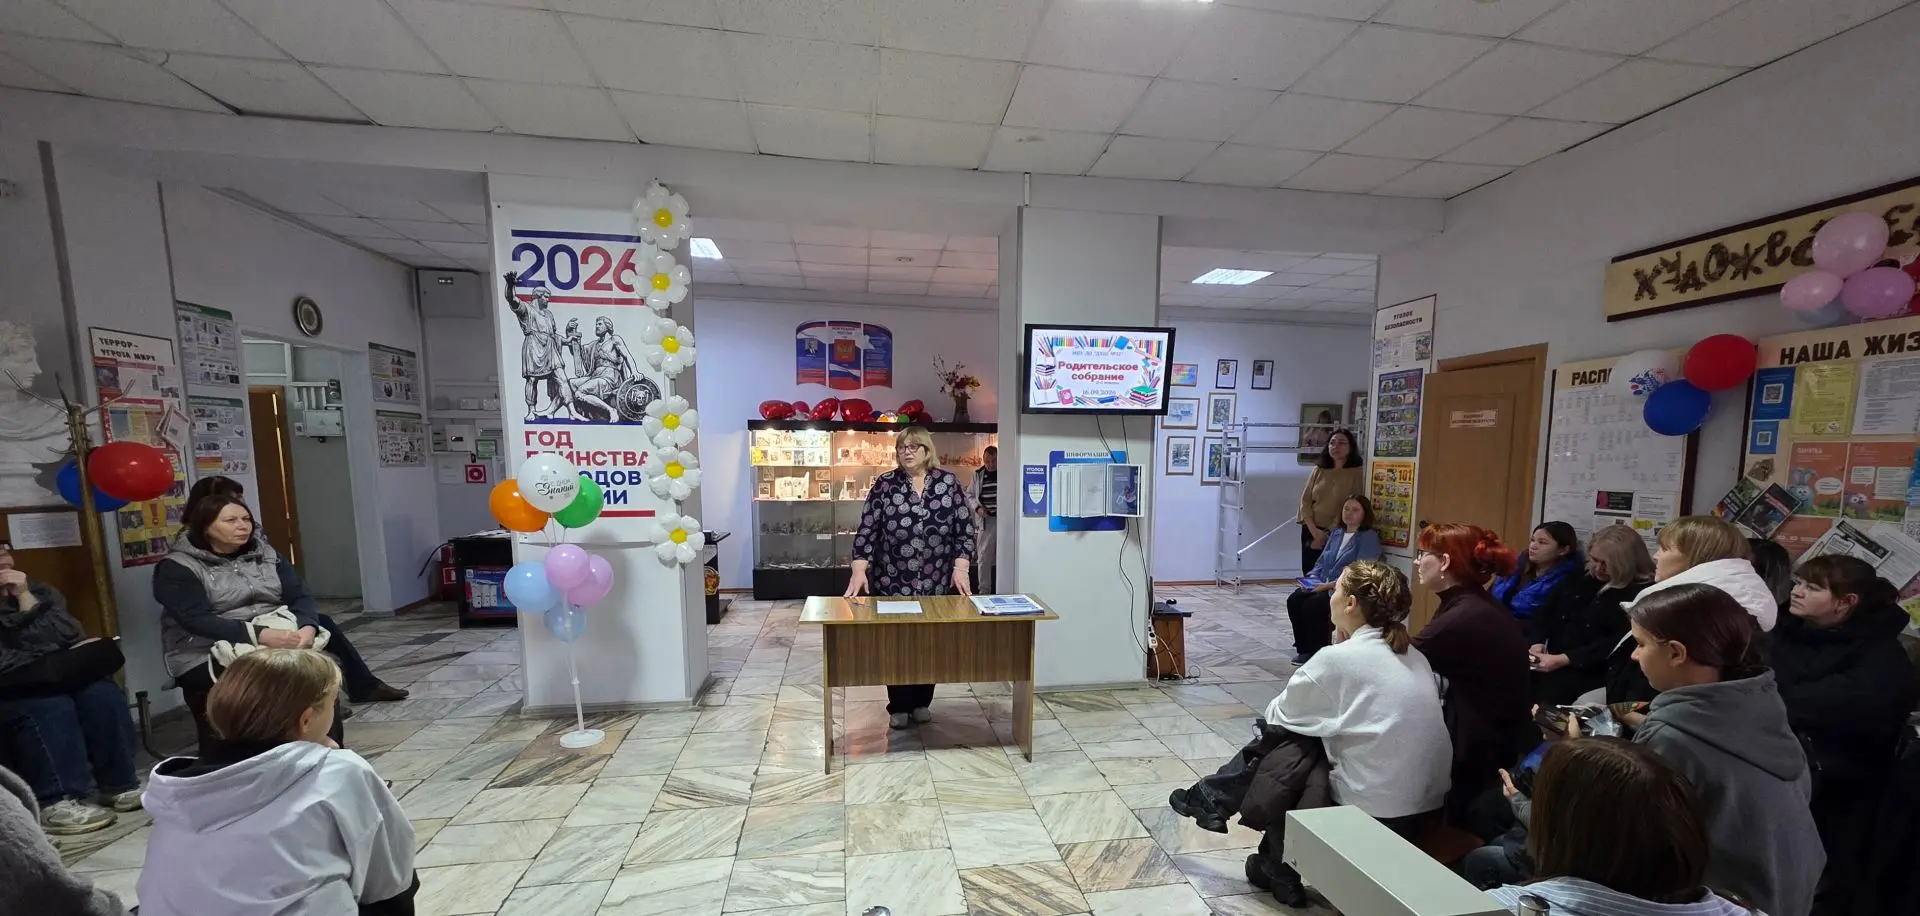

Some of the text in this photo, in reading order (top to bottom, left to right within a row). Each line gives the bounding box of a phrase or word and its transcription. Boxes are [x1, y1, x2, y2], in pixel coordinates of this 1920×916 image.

[512, 243, 637, 292] 2026
[100, 348, 156, 361] УГРОЗА МИРУ
[1779, 340, 1851, 365] НАША
[1058, 361, 1139, 371] Родительское
[1071, 372, 1125, 382] собрание
[525, 430, 573, 449] ГОД
[526, 450, 649, 467] ИНСТВА
[1398, 469, 1412, 482] 101
